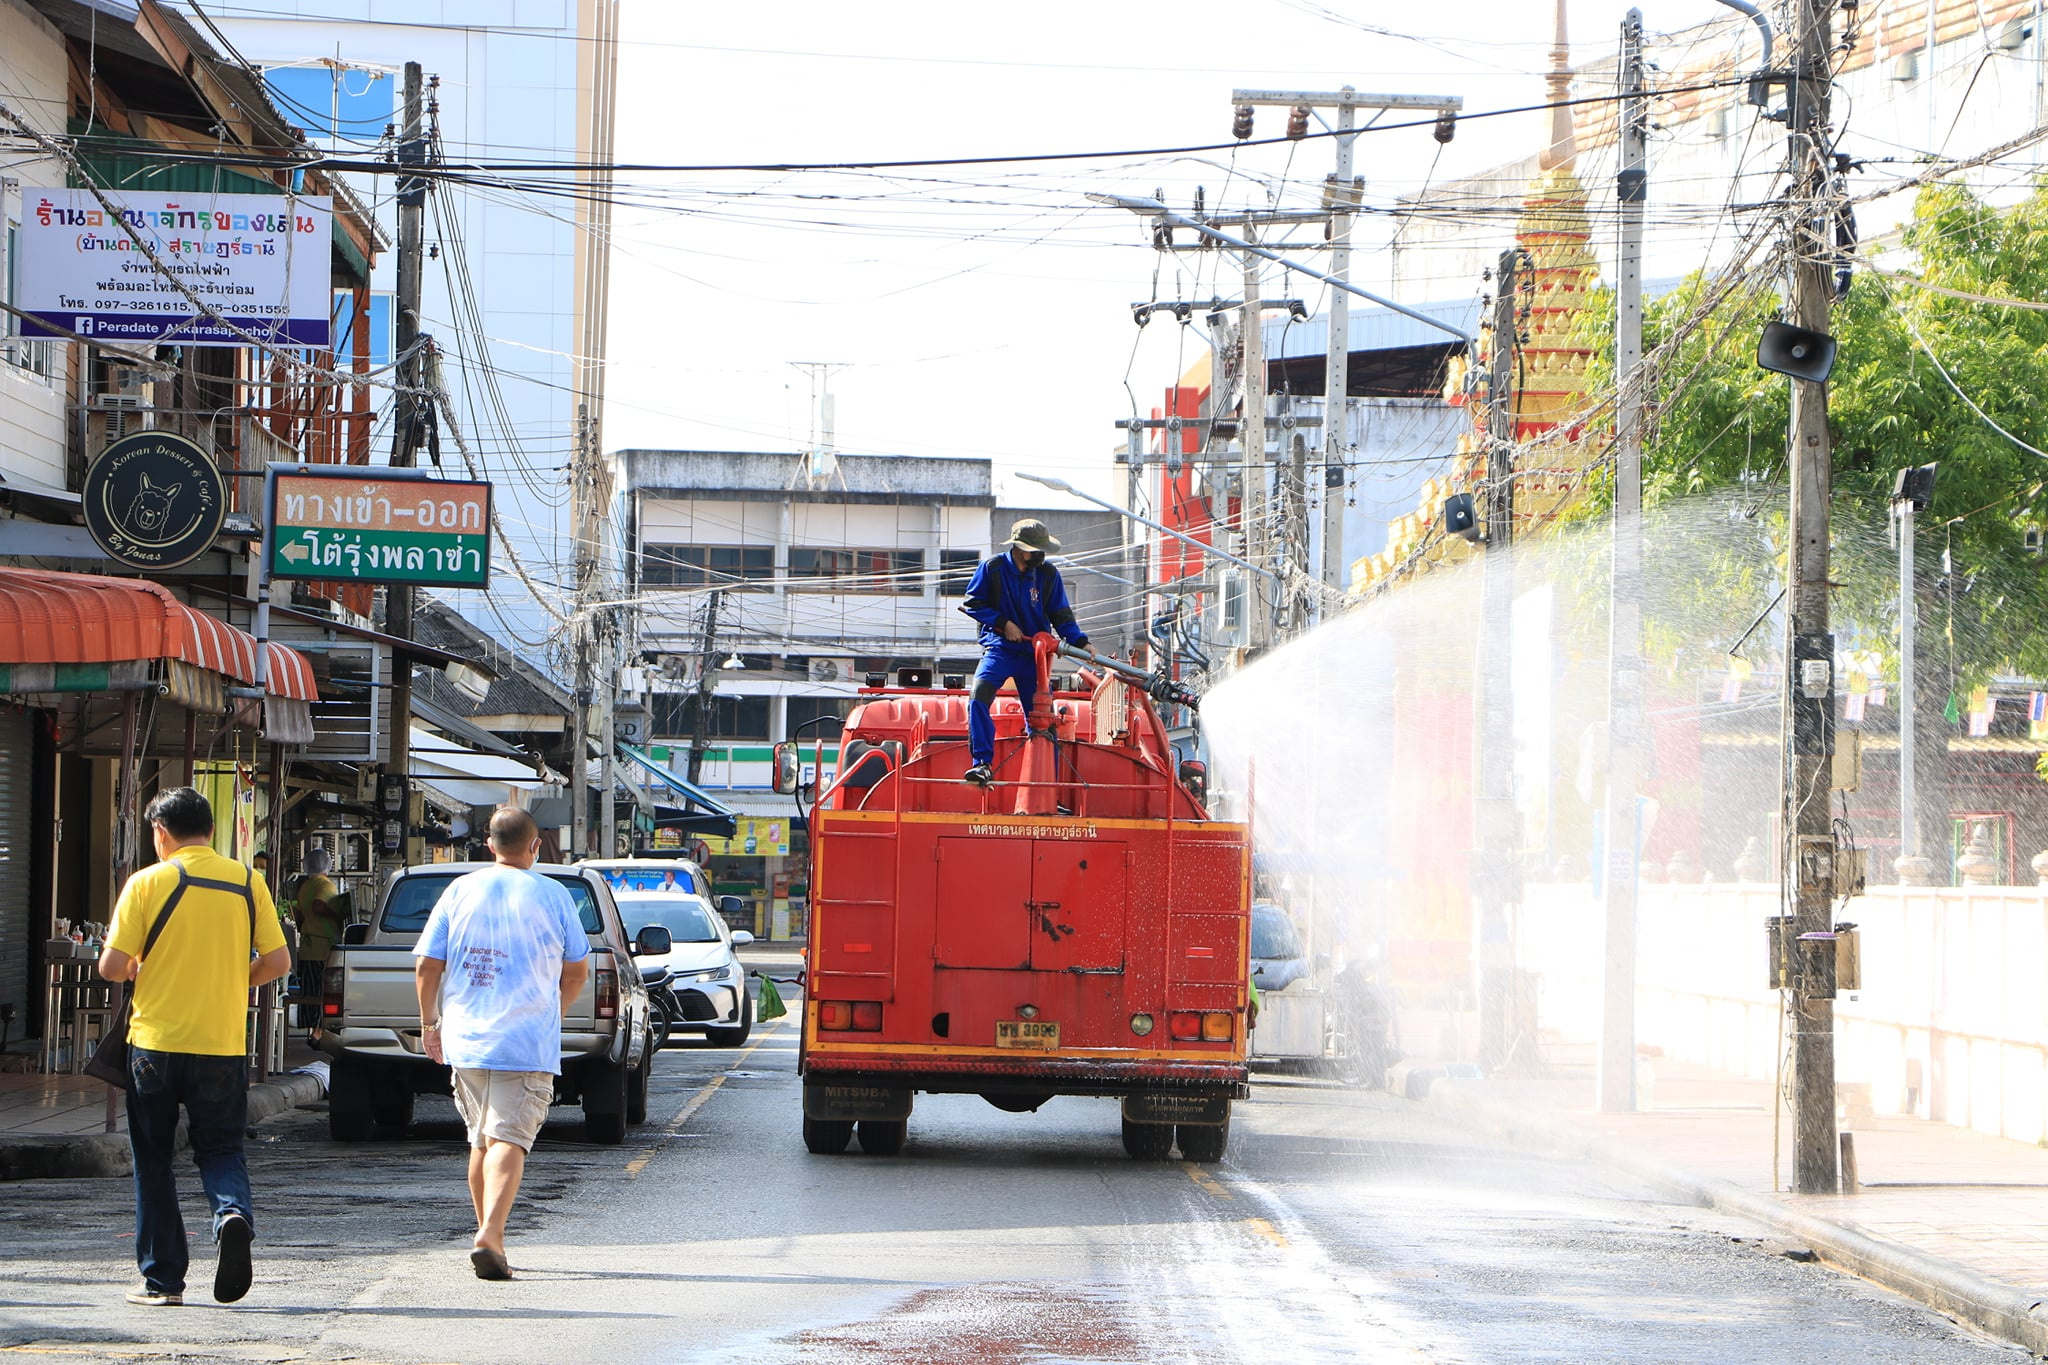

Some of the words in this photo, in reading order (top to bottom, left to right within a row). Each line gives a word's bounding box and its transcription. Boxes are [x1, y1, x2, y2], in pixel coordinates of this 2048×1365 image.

[169, 236, 275, 259] สุราษฎร์ธานี
[98, 321, 159, 334] Peradate
[112, 447, 150, 471] Korean
[156, 444, 195, 468] Dessert
[198, 480, 213, 507] Café
[285, 484, 480, 529] ทางเข้า-ออก
[108, 533, 124, 550] By
[123, 546, 162, 561] Jonas
[303, 530, 481, 576] โต้รุ่งพลาซ่า
[968, 823, 1098, 840] เทศบาลนครสุราษฎร์ธานี
